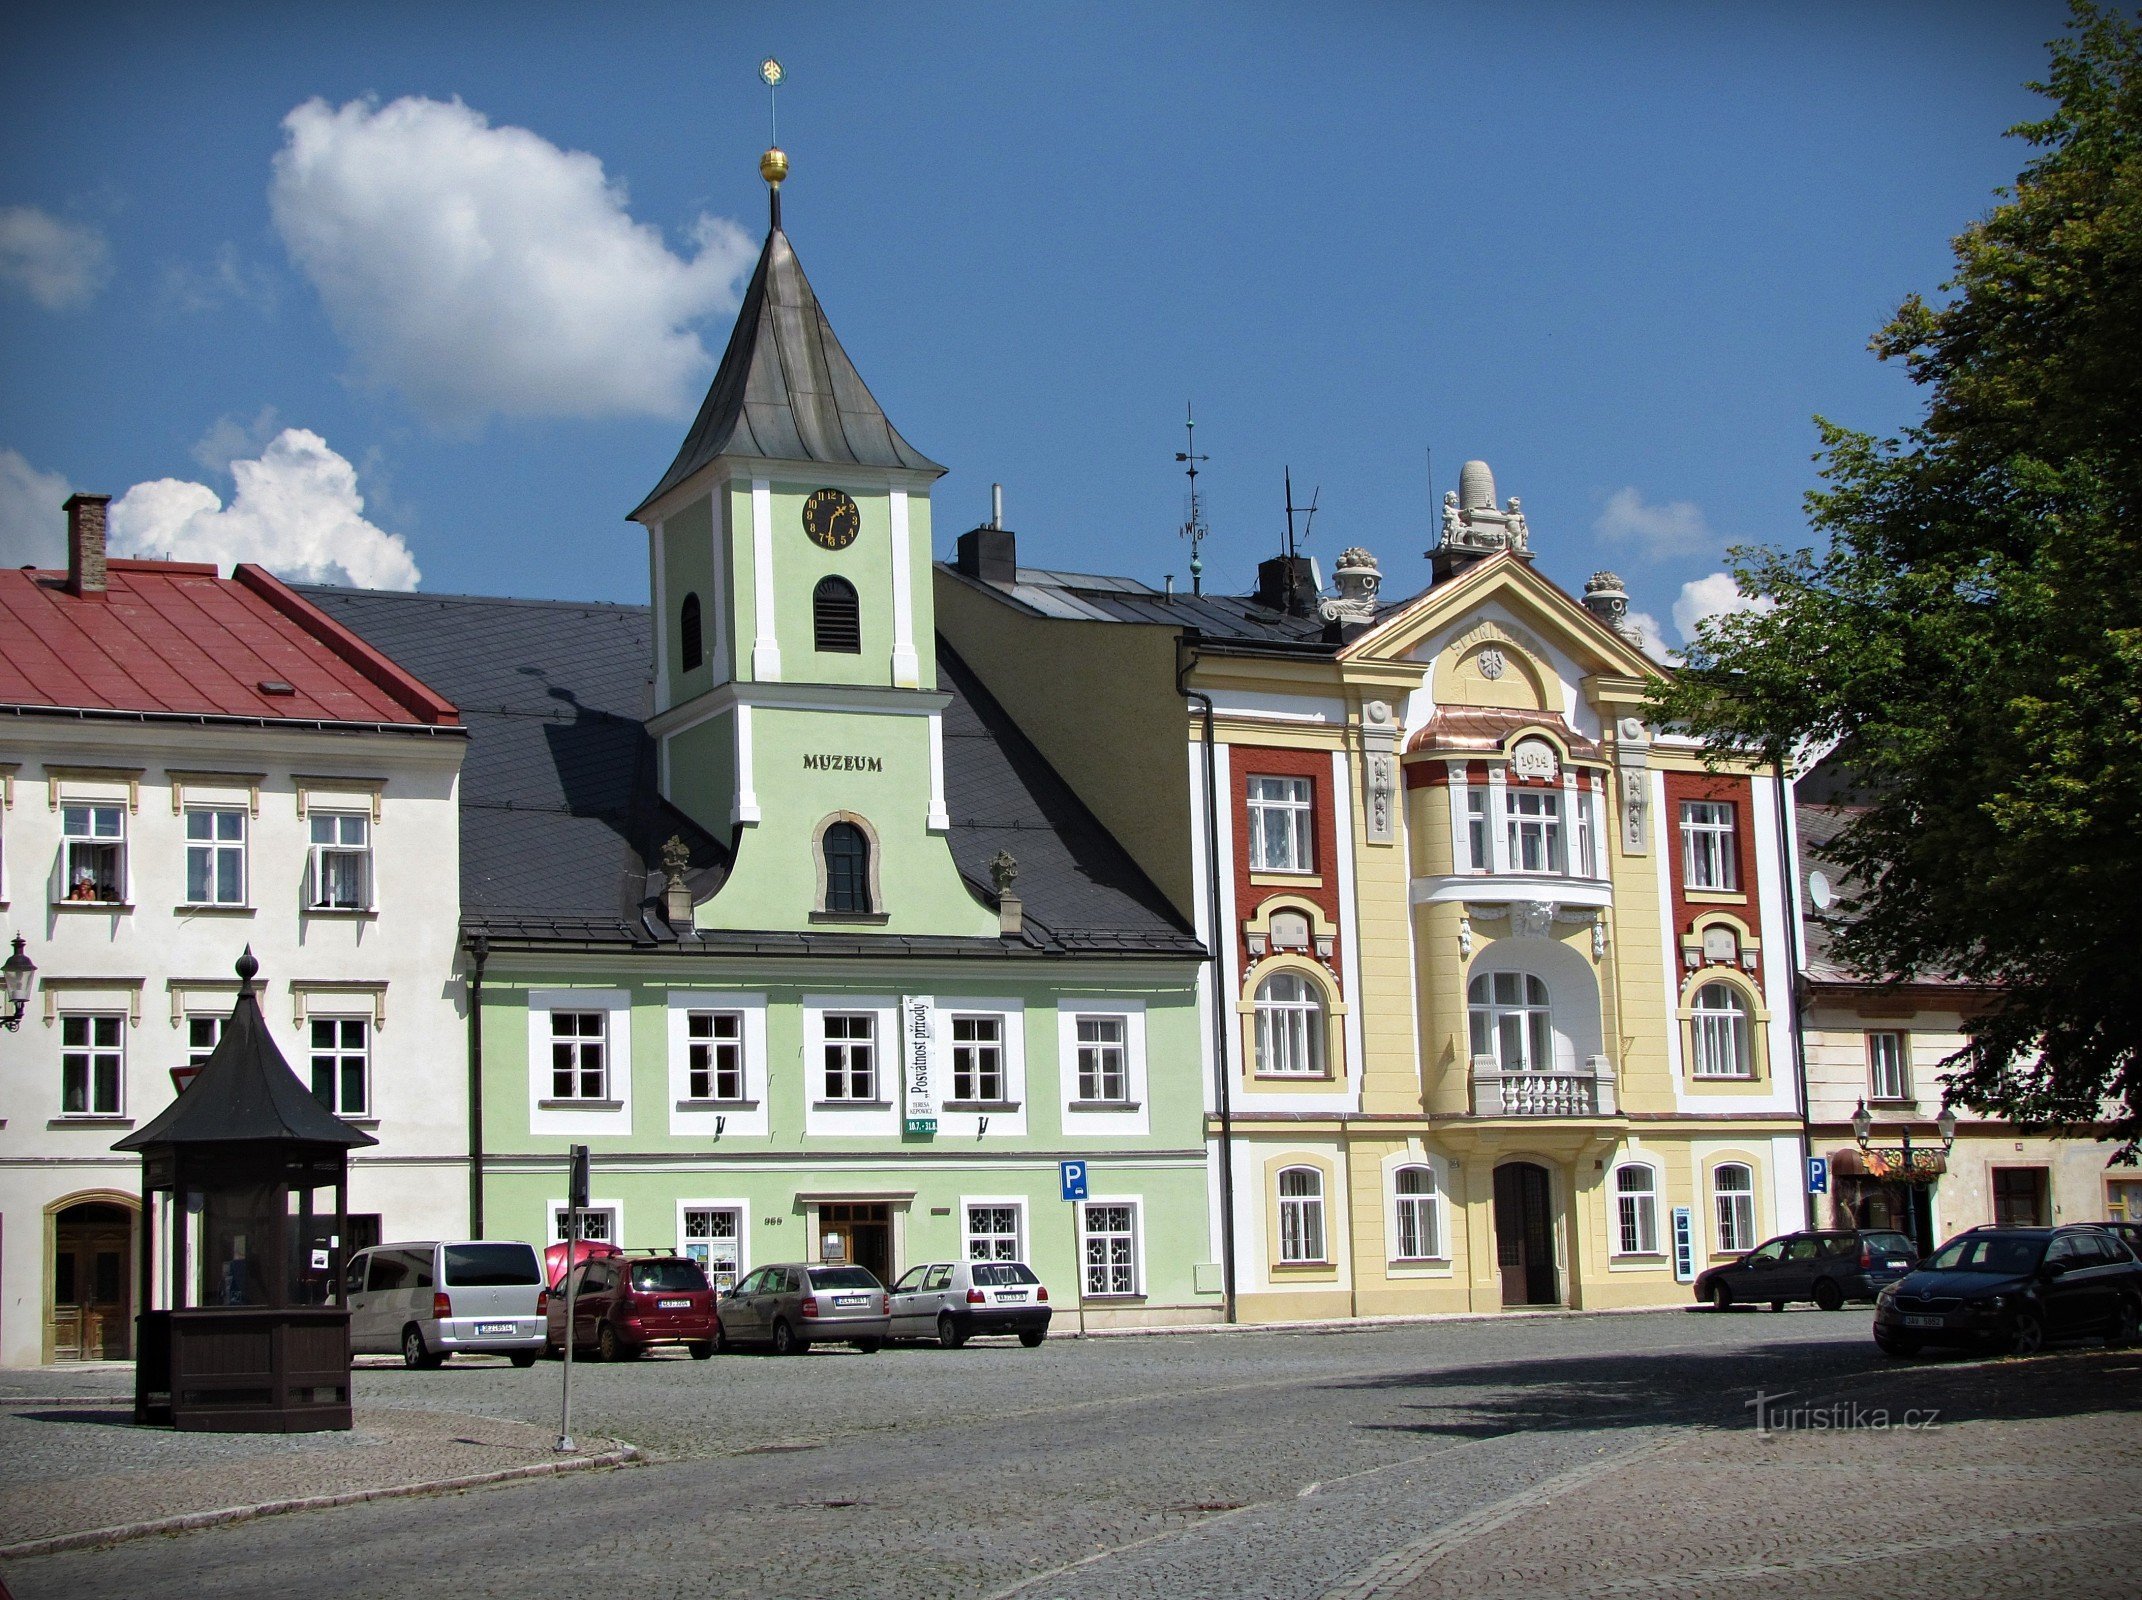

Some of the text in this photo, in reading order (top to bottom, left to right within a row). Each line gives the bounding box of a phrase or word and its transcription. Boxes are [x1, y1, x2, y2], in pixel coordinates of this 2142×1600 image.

[818, 492, 824, 501] 11
[828, 491, 836, 499] 12
[841, 494, 844, 503] 1
[808, 499, 817, 509] 10
[849, 504, 855, 513] 2
[807, 511, 812, 520] 9
[852, 516, 857, 525] 3
[810, 523, 815, 532] 8
[848, 528, 854, 537] 4
[819, 533, 824, 542] 7
[841, 536, 846, 544] 5
[803, 753, 883, 772] MUZEUM
[1520, 752, 1549, 771] 1914
[1811, 1161, 1823, 1182] P
[1065, 1165, 1081, 1189] P
